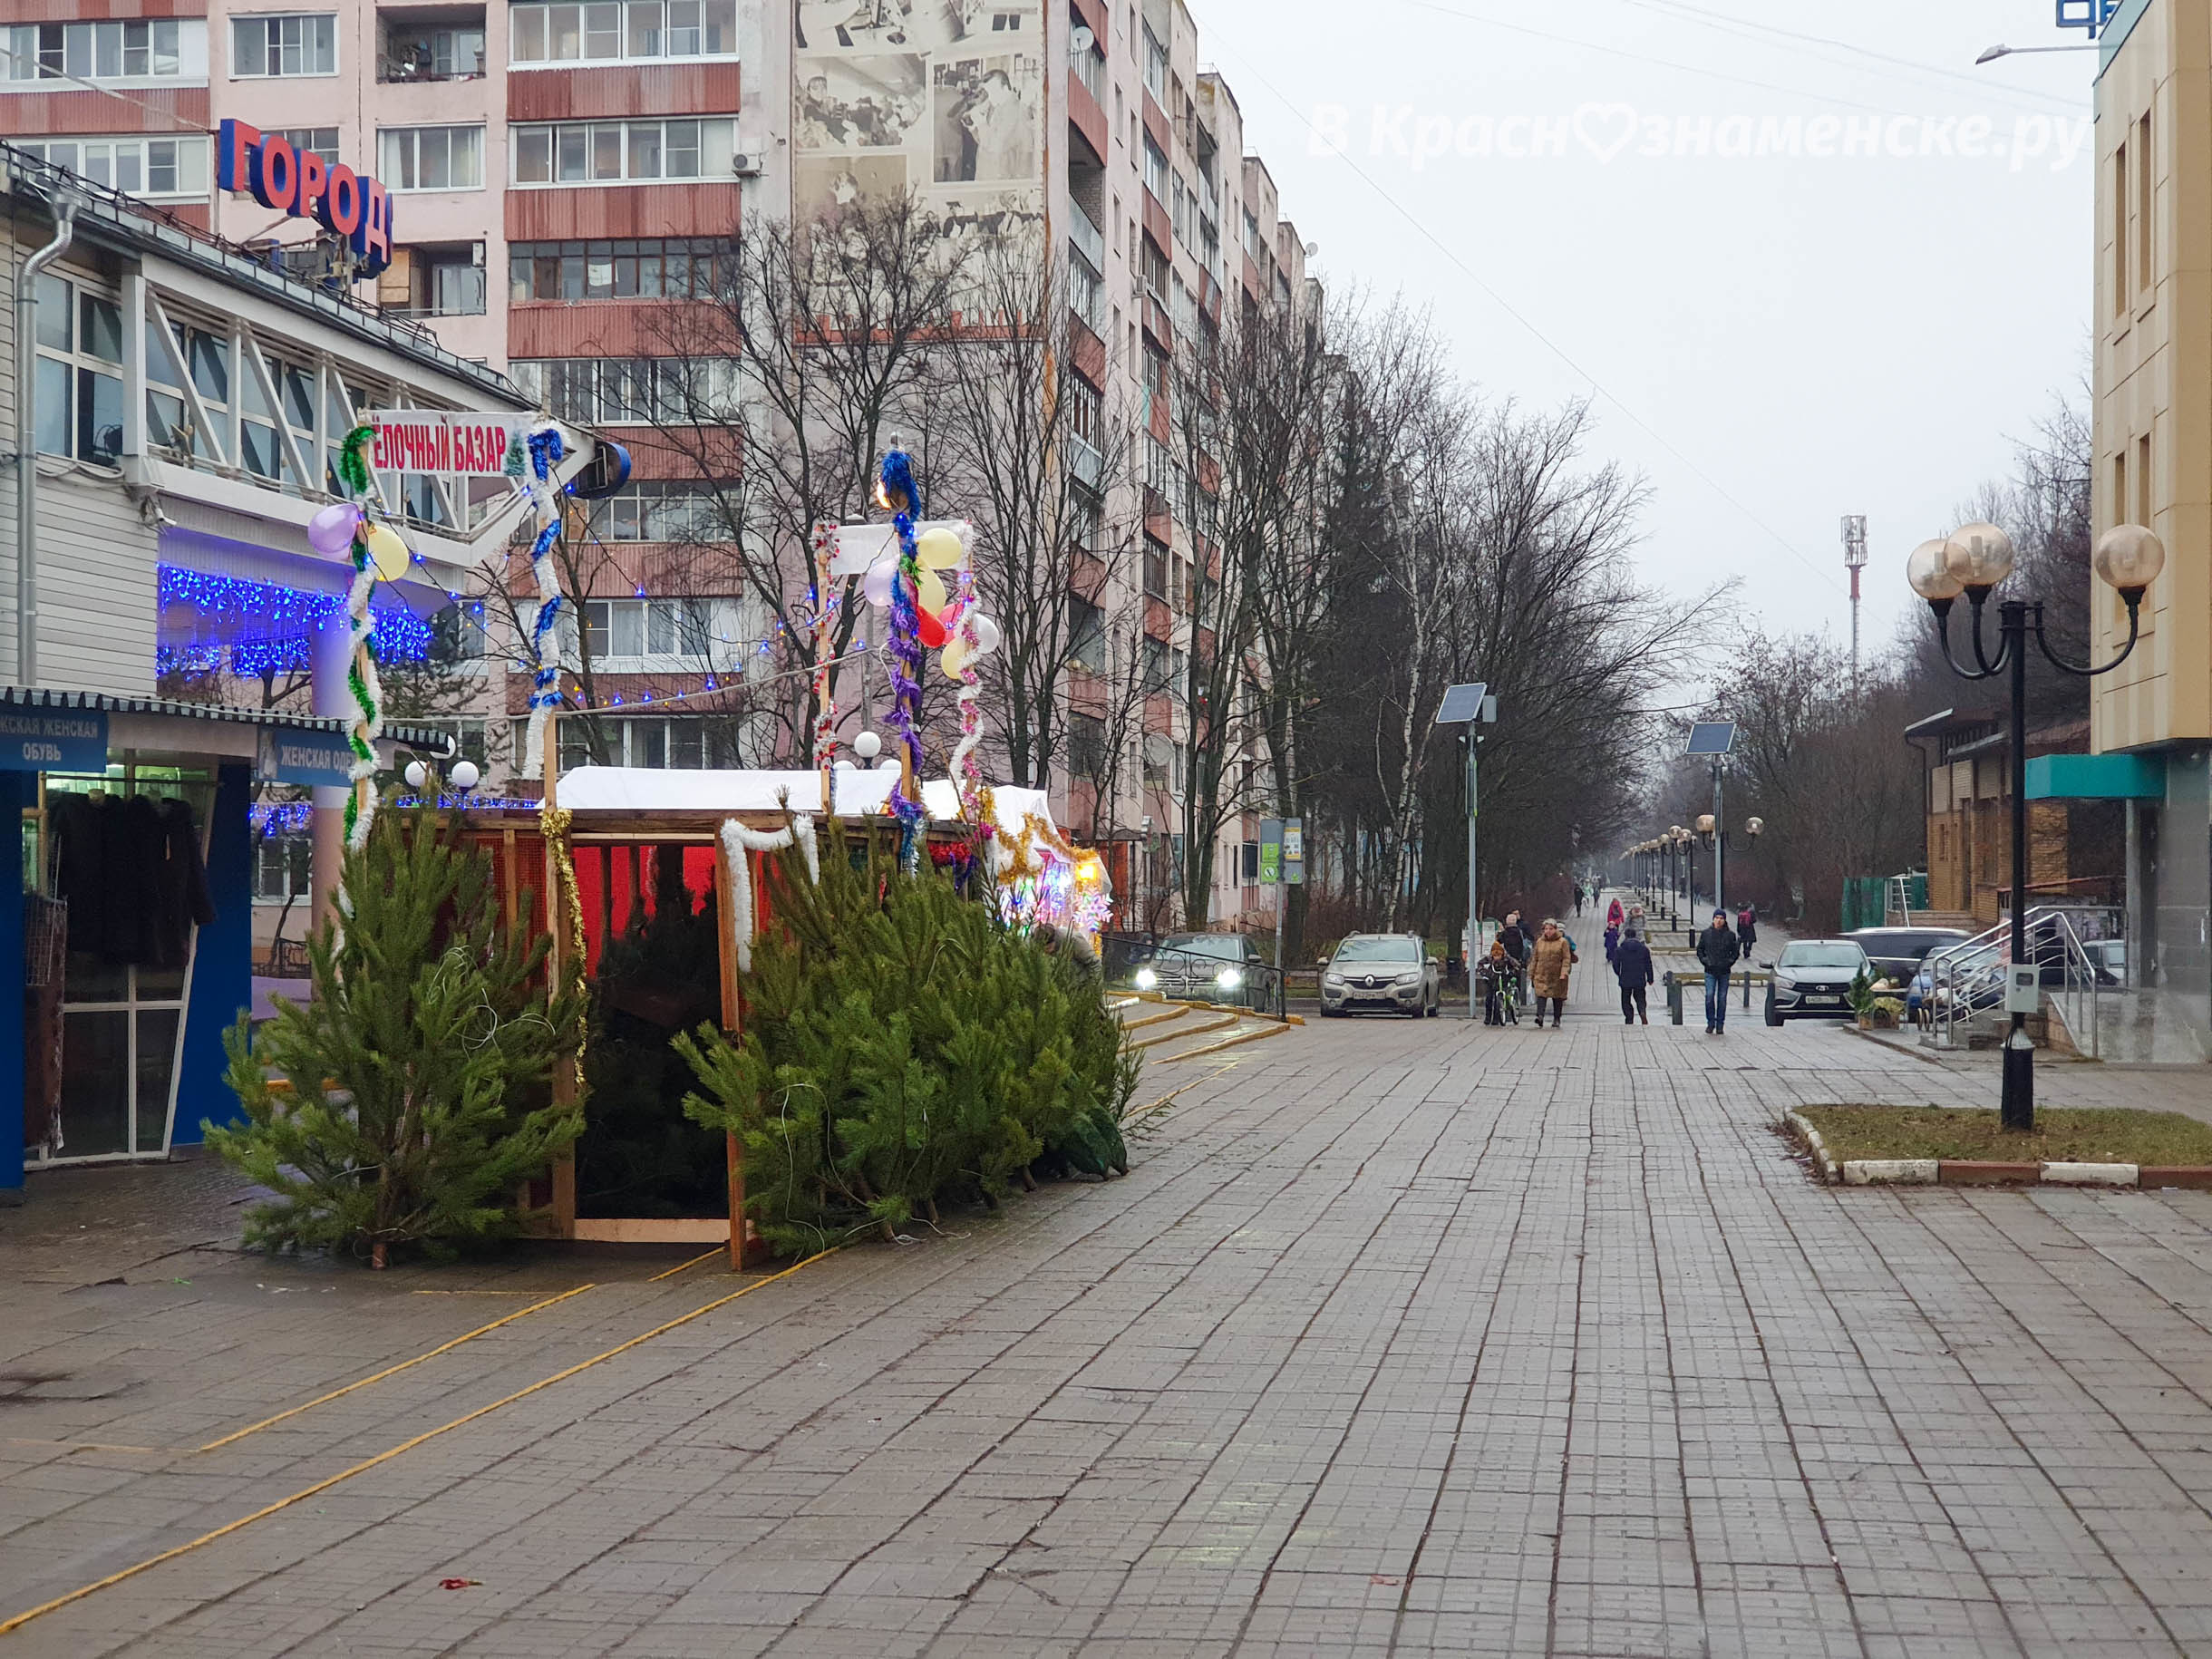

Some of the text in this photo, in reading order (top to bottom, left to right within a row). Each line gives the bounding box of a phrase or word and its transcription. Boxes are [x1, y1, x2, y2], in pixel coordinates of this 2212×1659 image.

[221, 119, 392, 272] ГОРОД
[372, 414, 507, 472] ЁЛОЧНЫЙ БАЗАР
[43, 718, 98, 738] ЖЕНСКАЯ
[23, 742, 62, 761] ОБУВЬ
[281, 745, 331, 769] ЖЕНСКАЯ
